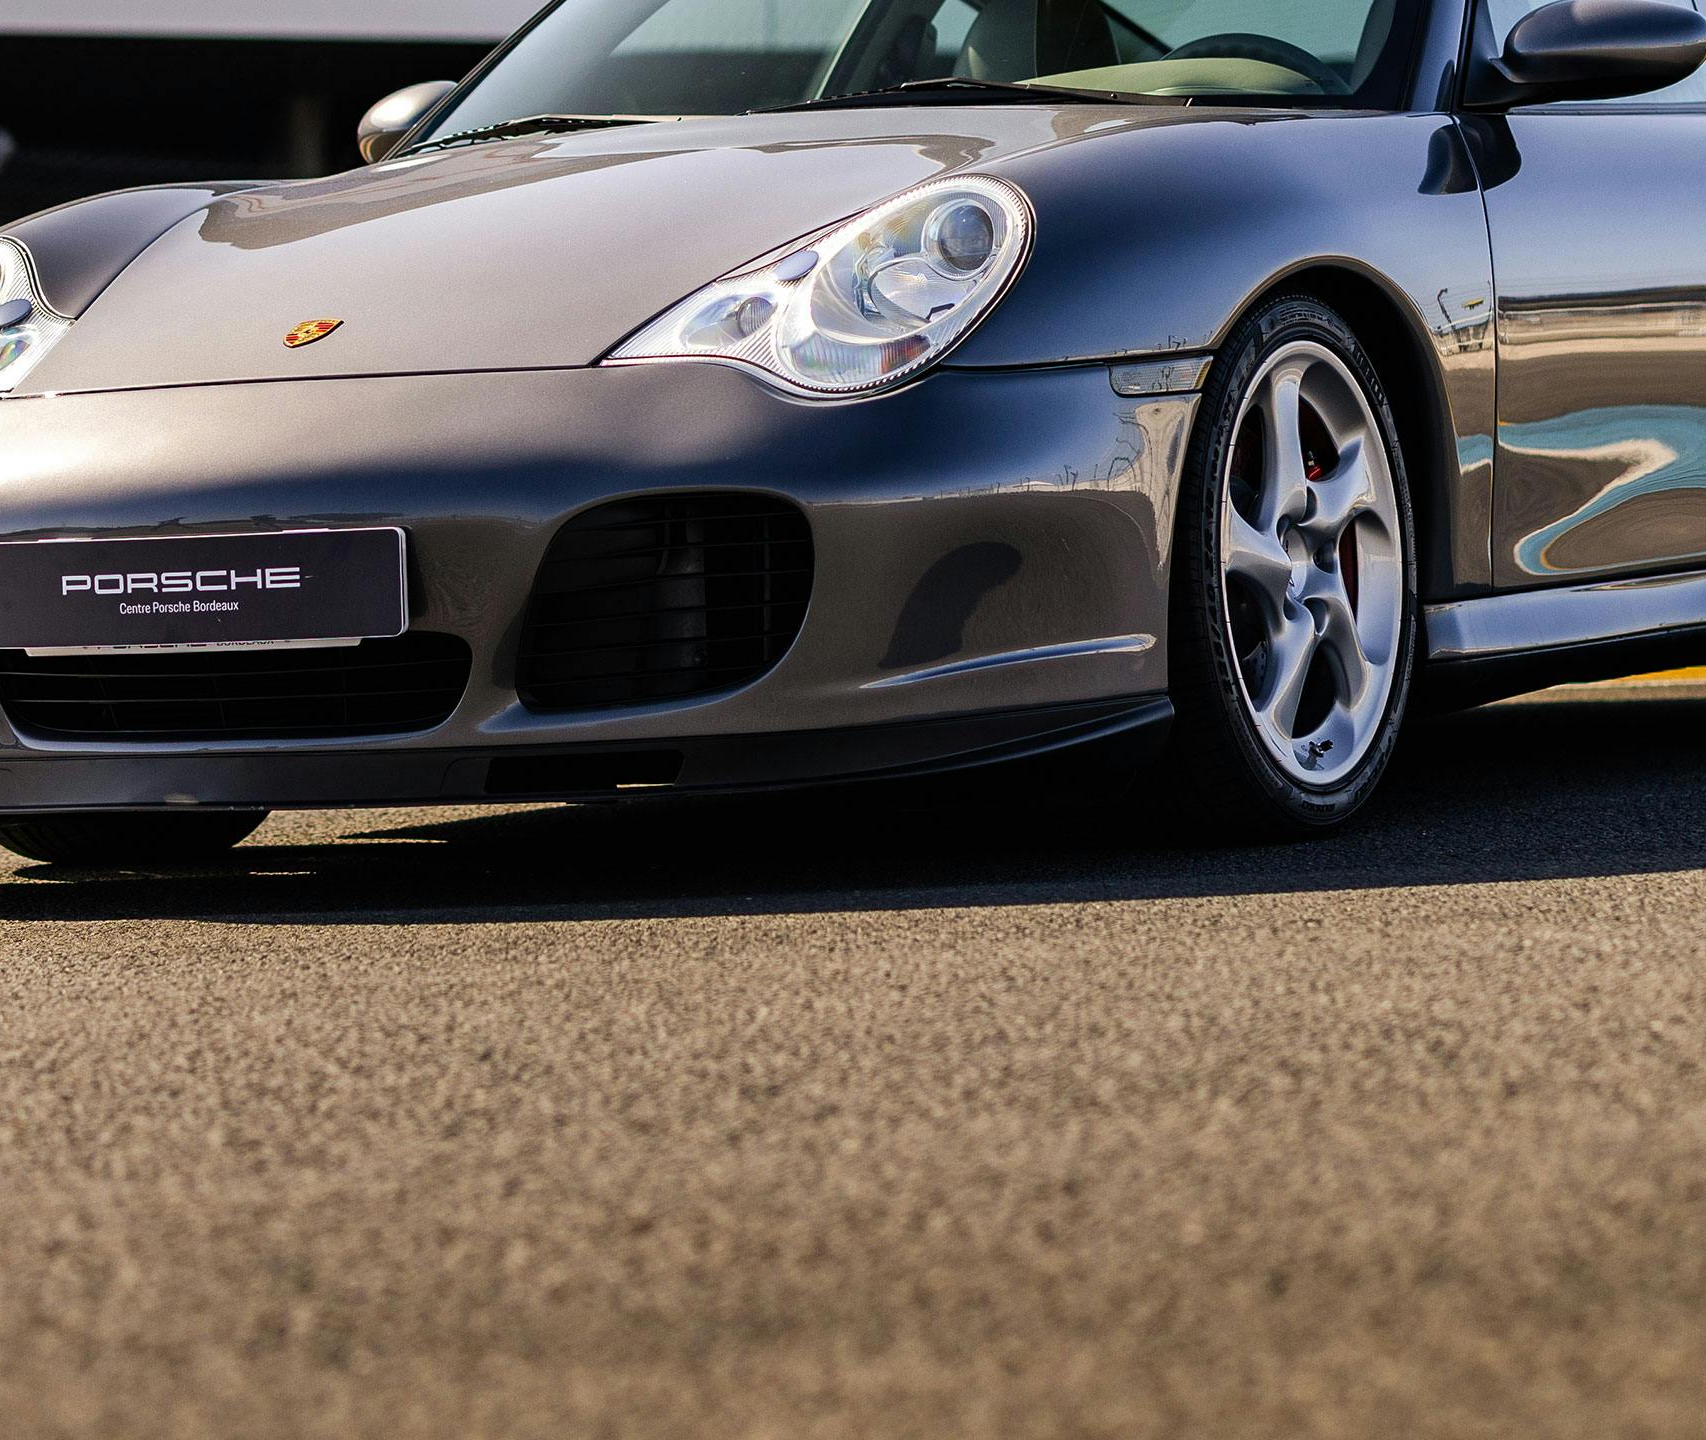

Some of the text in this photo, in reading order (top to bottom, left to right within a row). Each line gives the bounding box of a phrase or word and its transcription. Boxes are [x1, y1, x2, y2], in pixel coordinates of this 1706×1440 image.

[61, 567, 301, 596] PORSCHE
[119, 600, 239, 615] Centre Porsche Bordeaux
